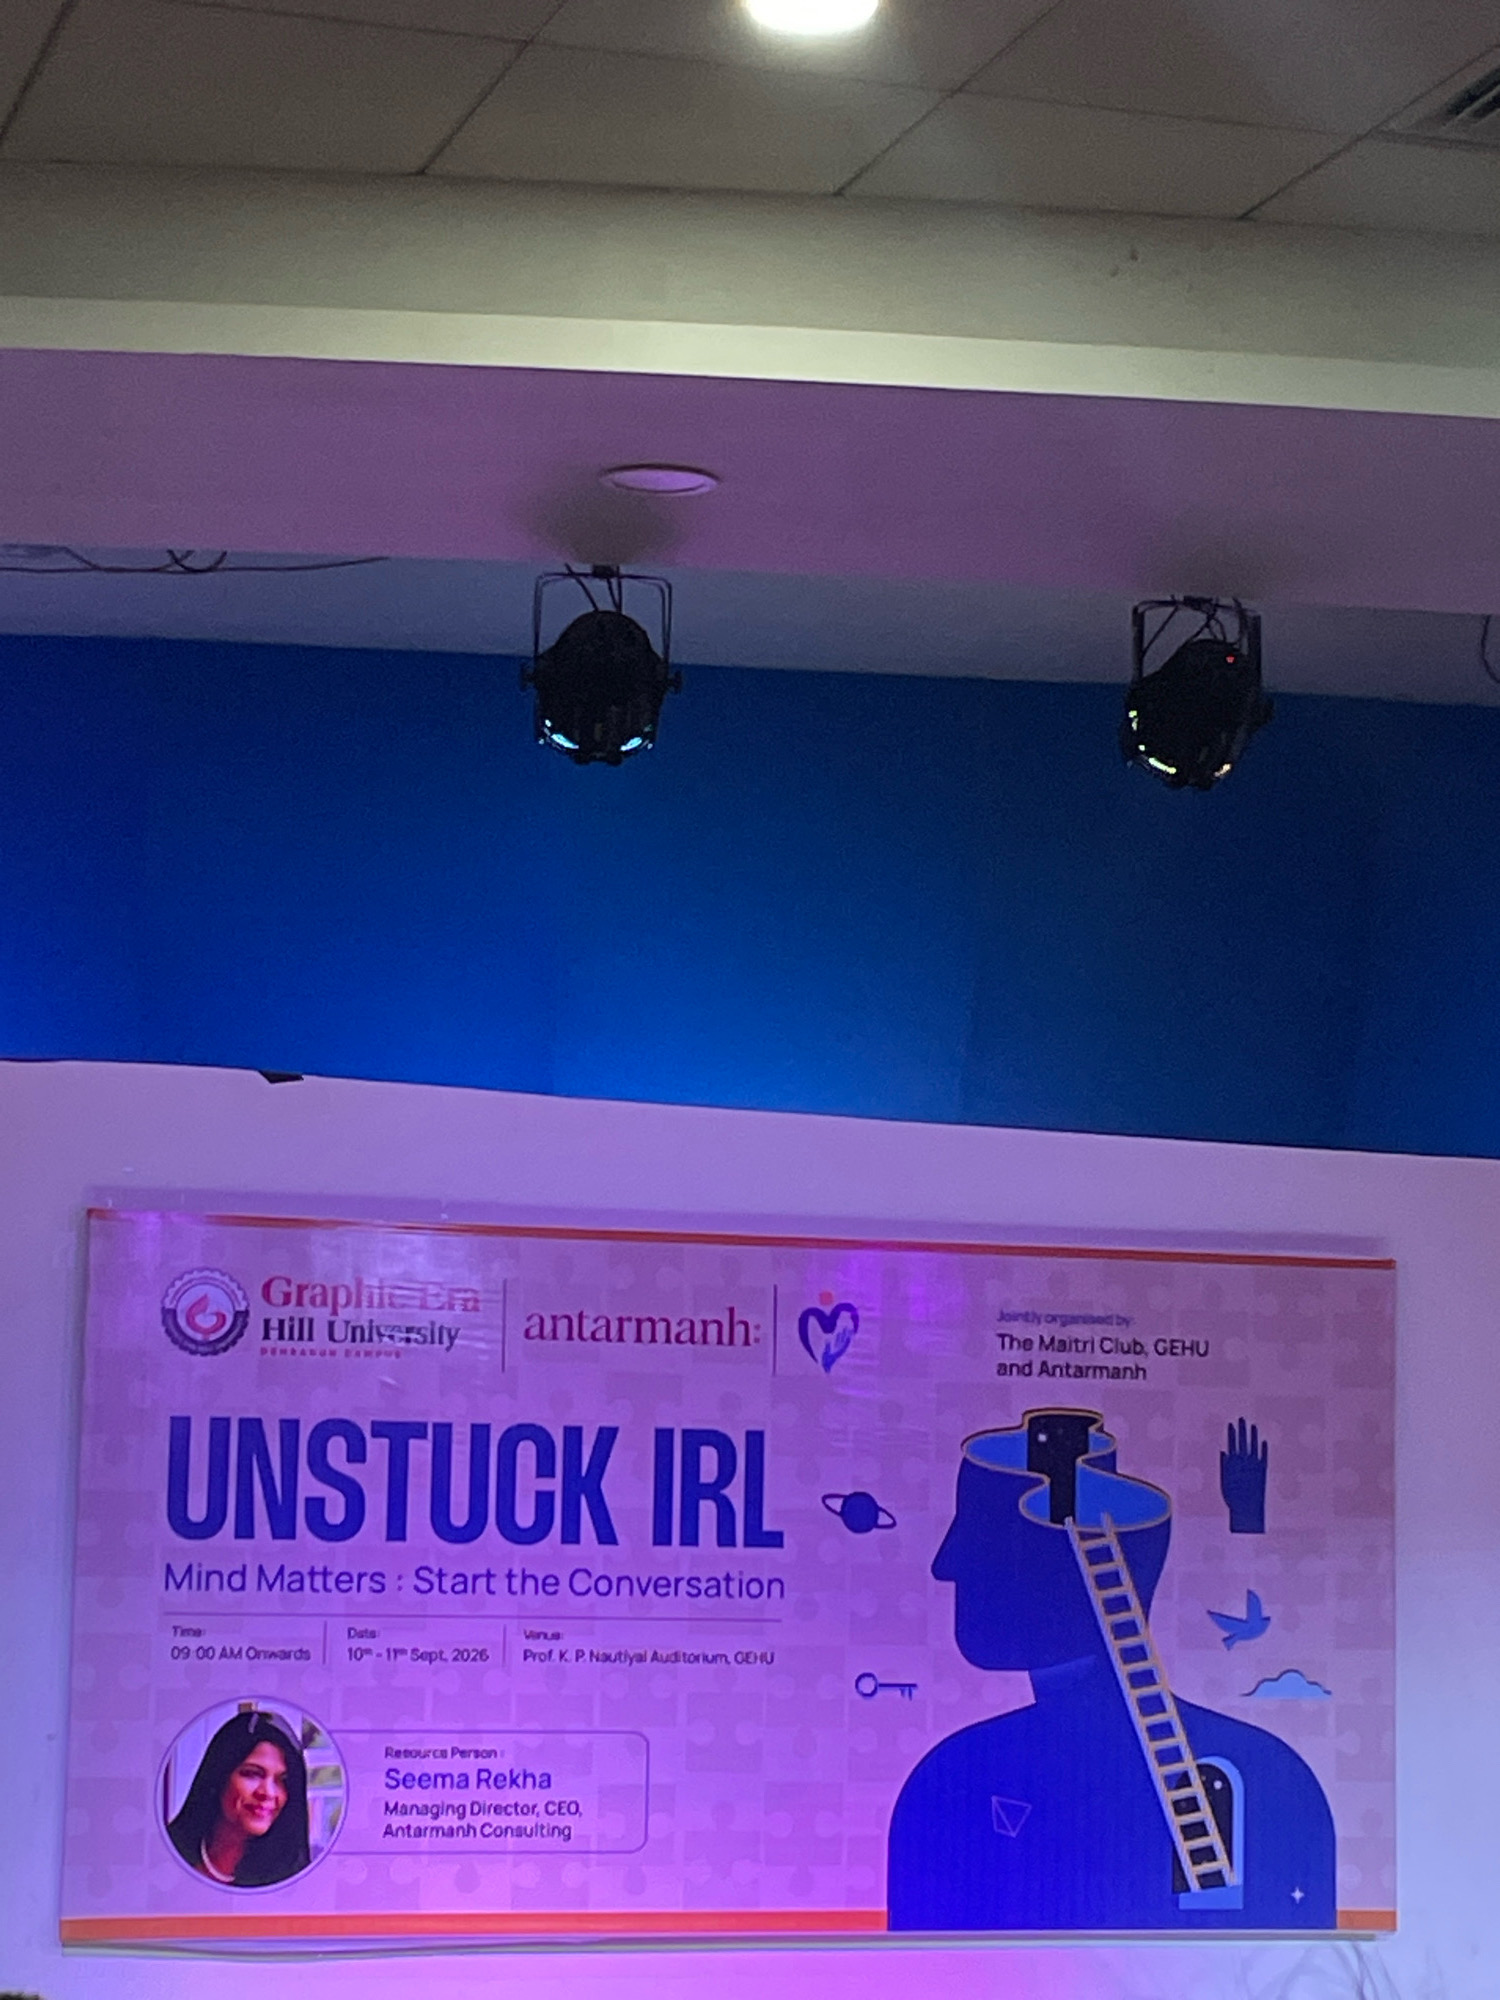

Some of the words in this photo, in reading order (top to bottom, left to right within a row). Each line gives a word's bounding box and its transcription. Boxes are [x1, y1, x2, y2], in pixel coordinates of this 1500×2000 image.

[261, 1275, 406, 1316] Graphic
[420, 1281, 481, 1312] Era
[997, 1311, 1040, 1325] Jointly
[1045, 1313, 1113, 1328] organised
[262, 1316, 314, 1342] Hill
[327, 1318, 461, 1351] University
[997, 1334, 1033, 1351] The
[1039, 1334, 1095, 1354] Maitri
[1099, 1336, 1149, 1357] Club,
[1153, 1338, 1209, 1357] GEHU
[996, 1361, 1033, 1377] and
[1037, 1360, 1147, 1380] Antarmanh
[166, 1415, 619, 1546] UNSTUCK
[651, 1427, 785, 1549] IRL
[164, 1562, 248, 1593] Mind
[257, 1564, 386, 1594] Matters
[413, 1565, 497, 1596] Start
[505, 1568, 560, 1596] the
[568, 1568, 785, 1600] Conversation
[171, 1646, 215, 1661] 09:00
[218, 1646, 243, 1661] AM
[245, 1646, 311, 1661] Onwards
[452, 1648, 490, 1662] 2026
[523, 1649, 555, 1663] Prof.
[559, 1649, 571, 1663] K.
[575, 1650, 587, 1664] P.
[590, 1650, 647, 1667] Nautiyal
[650, 1650, 731, 1666] Auditorium,
[734, 1652, 775, 1665] GEHU
[385, 1746, 448, 1759] Resource
[451, 1746, 498, 1759] Person
[385, 1768, 470, 1790] Seema
[476, 1768, 552, 1790] Rekha
[384, 1801, 466, 1820] Managing
[470, 1801, 540, 1818] Director,
[544, 1801, 583, 1818] CEO,
[383, 1823, 476, 1839] Antarmanh
[480, 1822, 572, 1842] Consulting
